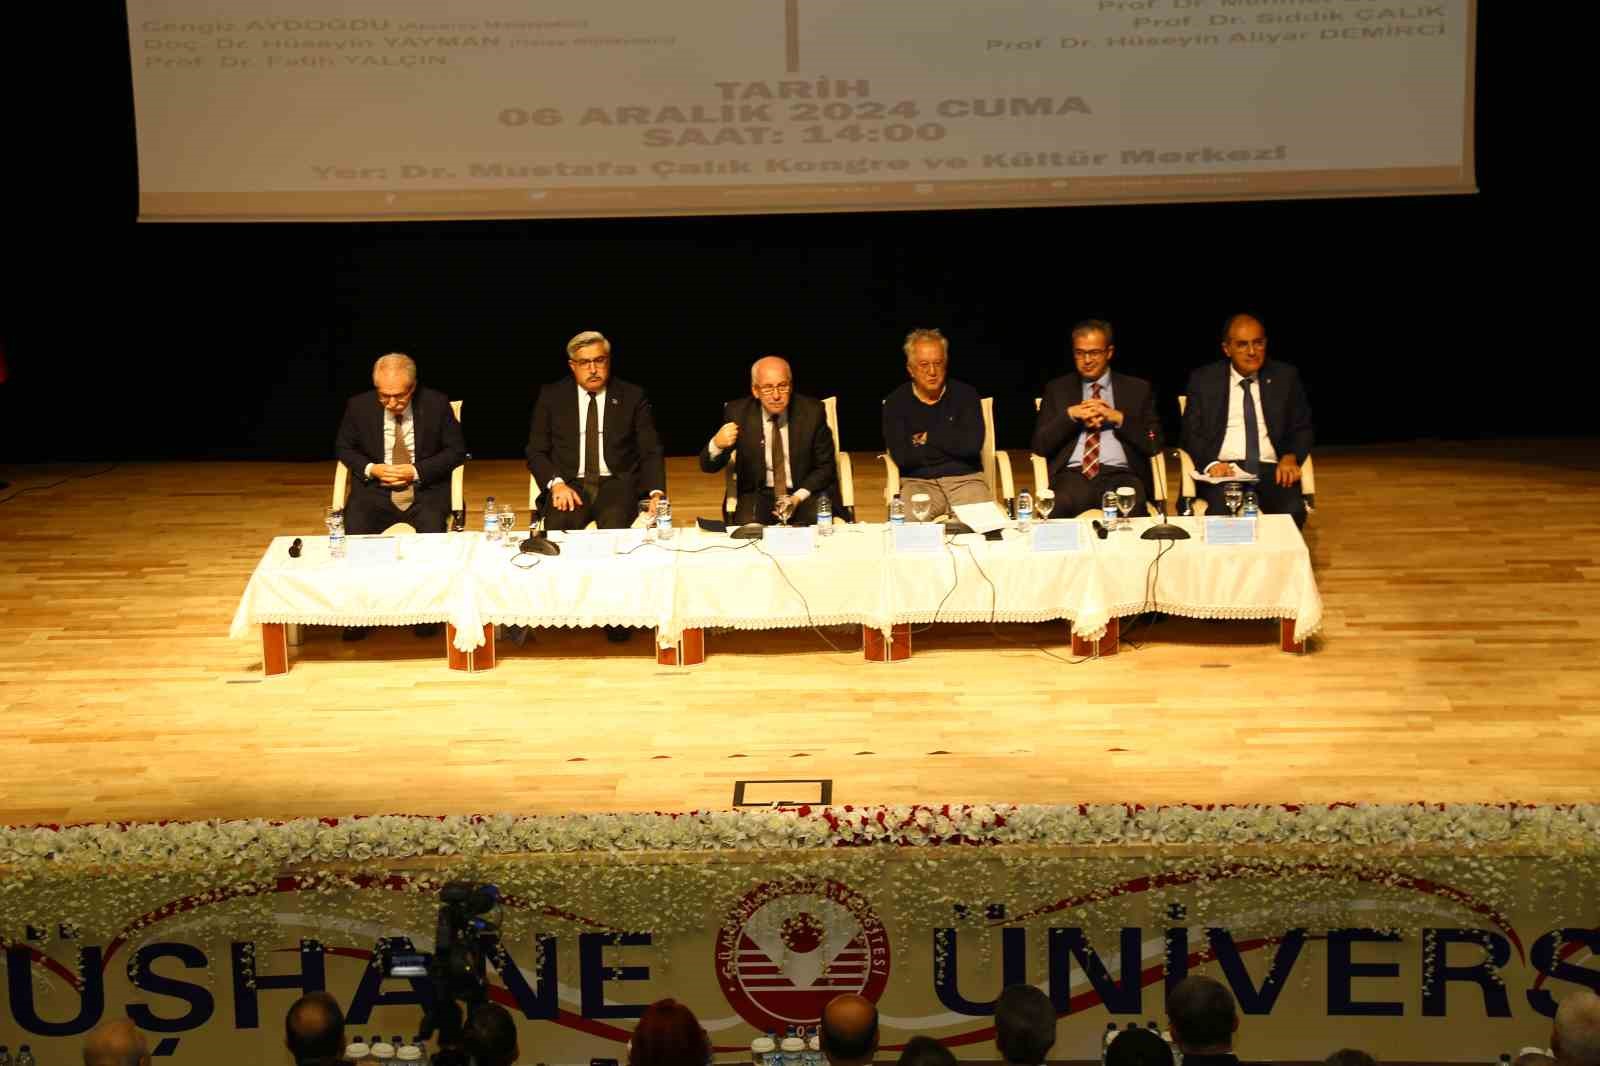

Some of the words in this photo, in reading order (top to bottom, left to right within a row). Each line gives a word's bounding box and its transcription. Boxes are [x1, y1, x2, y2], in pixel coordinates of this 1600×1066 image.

[383, 36, 501, 49] YAYMAN
[714, 75, 870, 100] TARİH
[498, 107, 563, 127] 06
[579, 103, 773, 127] ARALIK
[788, 101, 921, 122] 2024
[935, 96, 1093, 118] CUMA
[642, 126, 786, 148] SAAT:
[800, 122, 946, 144] 14:00
[400, 163, 457, 179] Dr.
[467, 160, 640, 177] Mustafa
[766, 157, 910, 175] Kongre
[923, 157, 969, 169] ve
[982, 150, 1109, 168] Kültür
[1119, 145, 1288, 165] Merkezi
